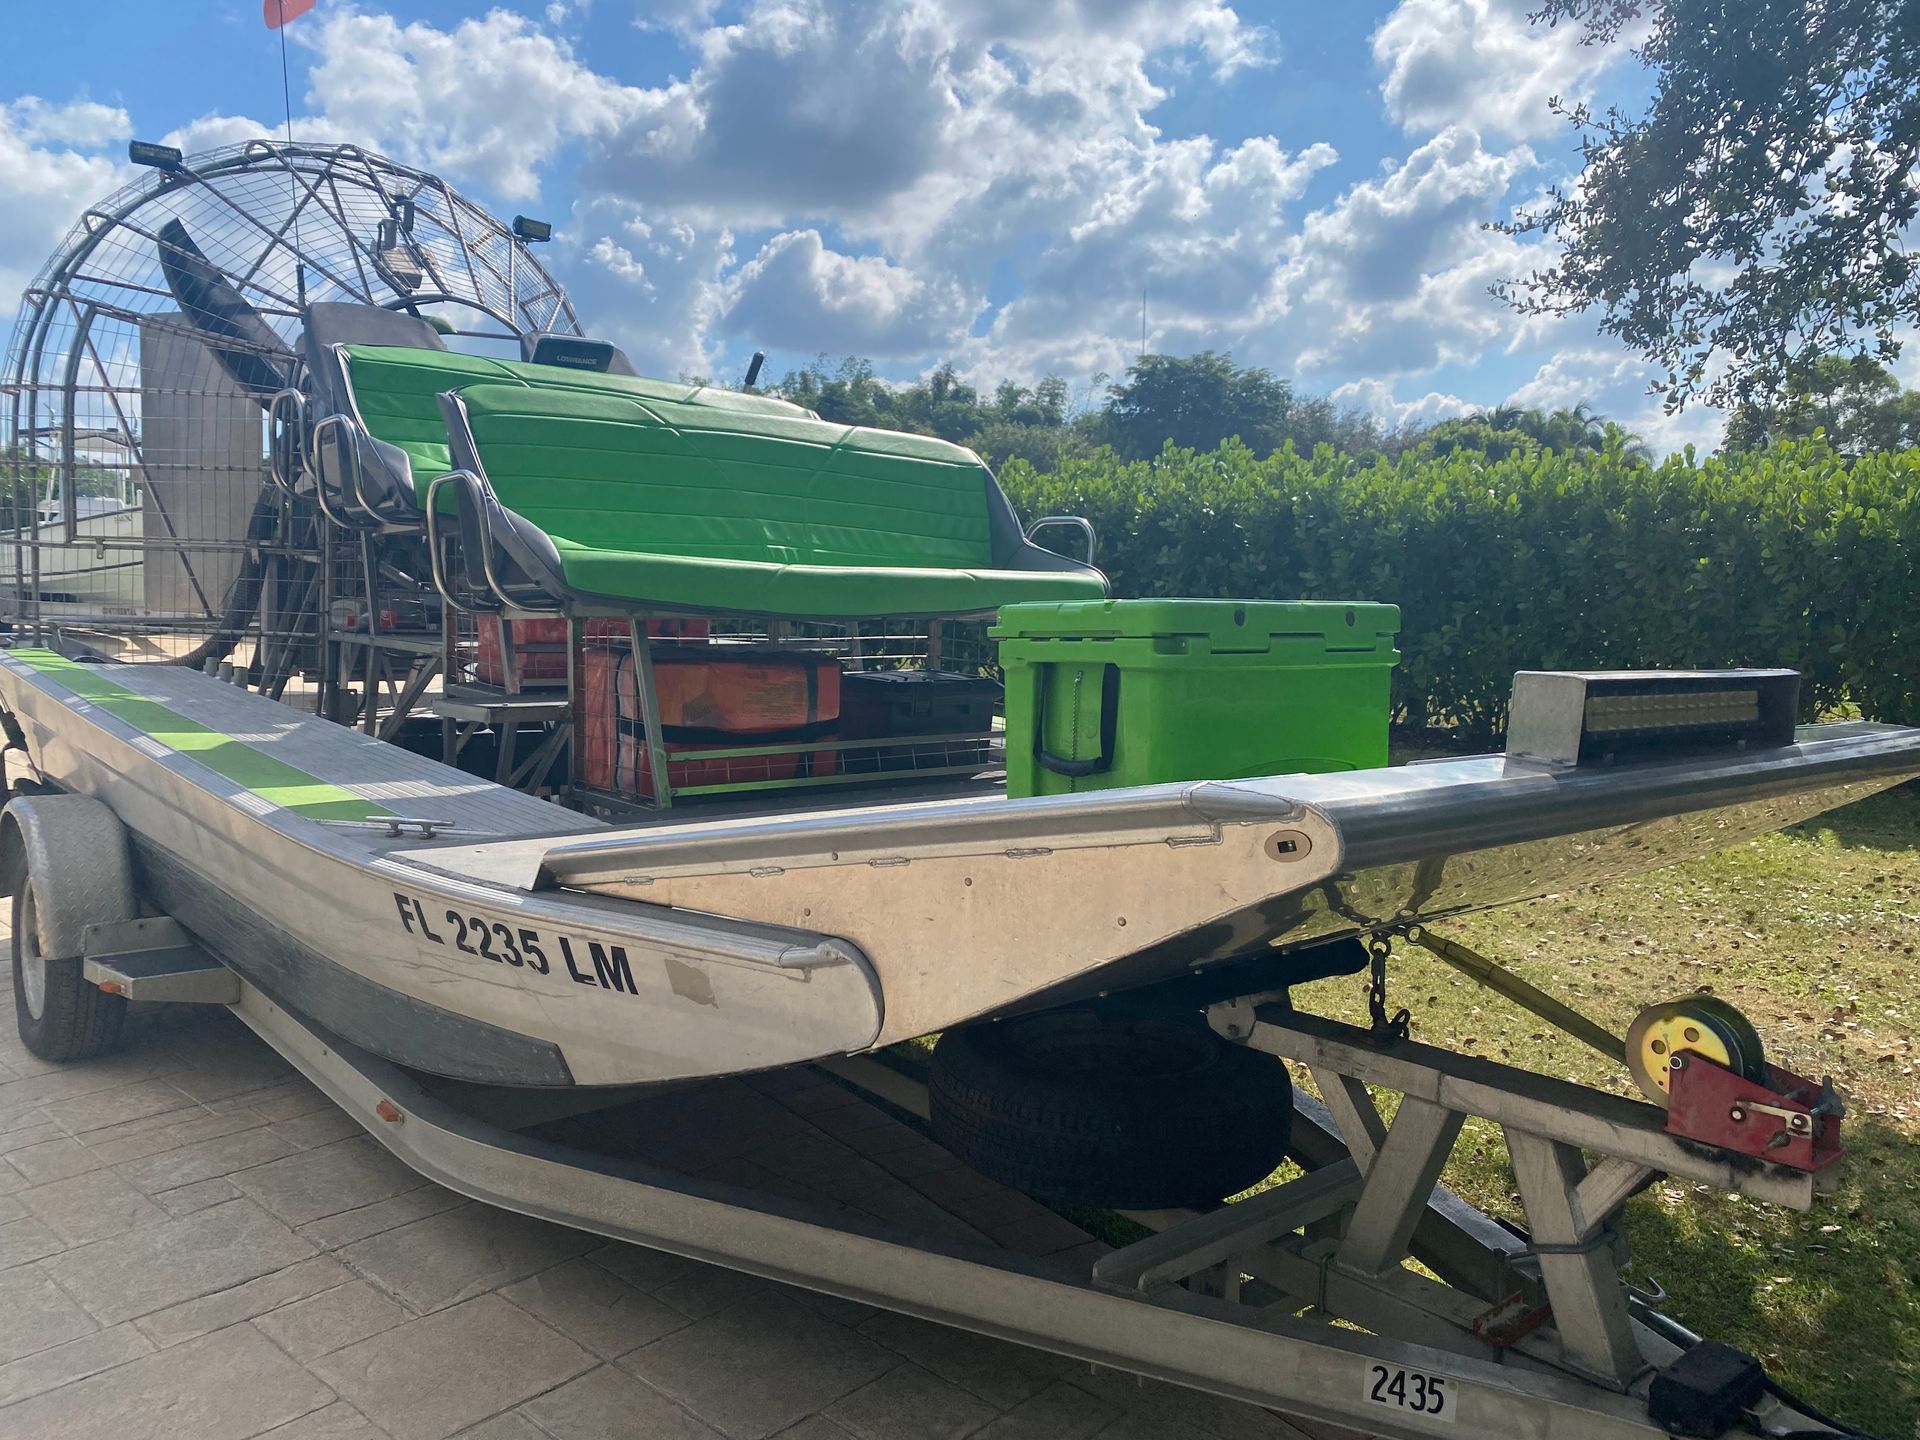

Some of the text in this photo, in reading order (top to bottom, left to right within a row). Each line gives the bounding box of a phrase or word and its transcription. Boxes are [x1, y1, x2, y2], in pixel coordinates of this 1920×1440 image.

[556, 355, 598, 365] LOWRANCE
[393, 892, 639, 995] FL 2235 LM
[1370, 1365, 1445, 1414] 2435
